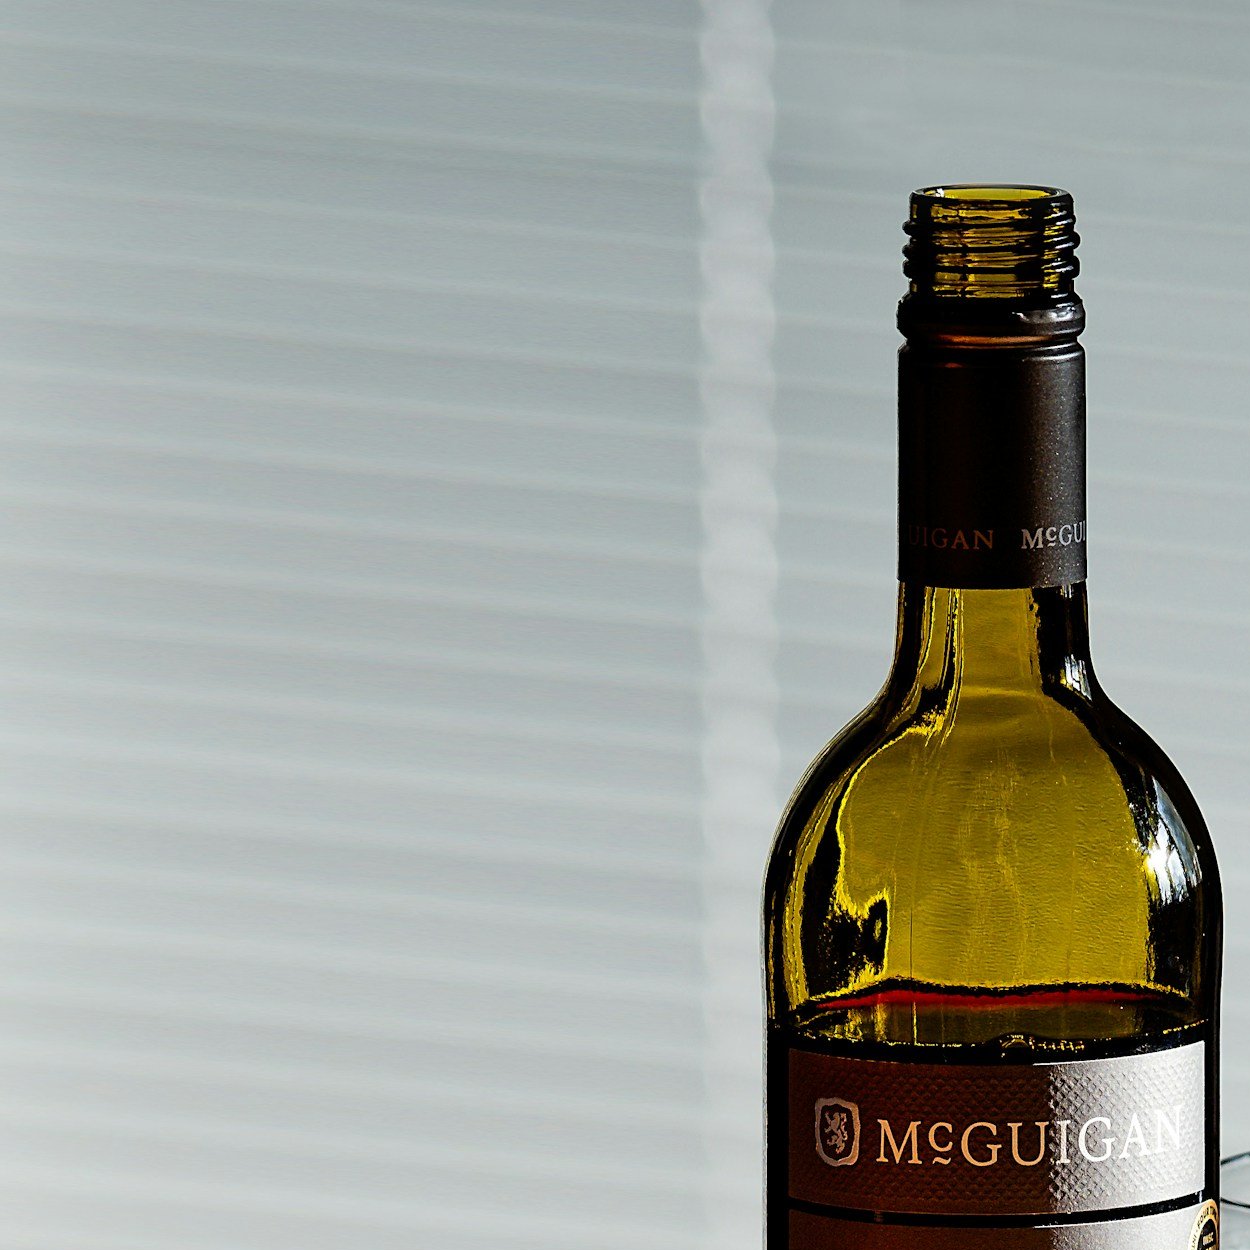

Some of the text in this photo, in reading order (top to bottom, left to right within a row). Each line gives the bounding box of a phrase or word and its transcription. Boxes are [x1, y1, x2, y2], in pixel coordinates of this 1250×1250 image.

[907, 520, 1086, 549] UIGAN McGUI
[875, 1104, 1184, 1167] McGUIGAN
